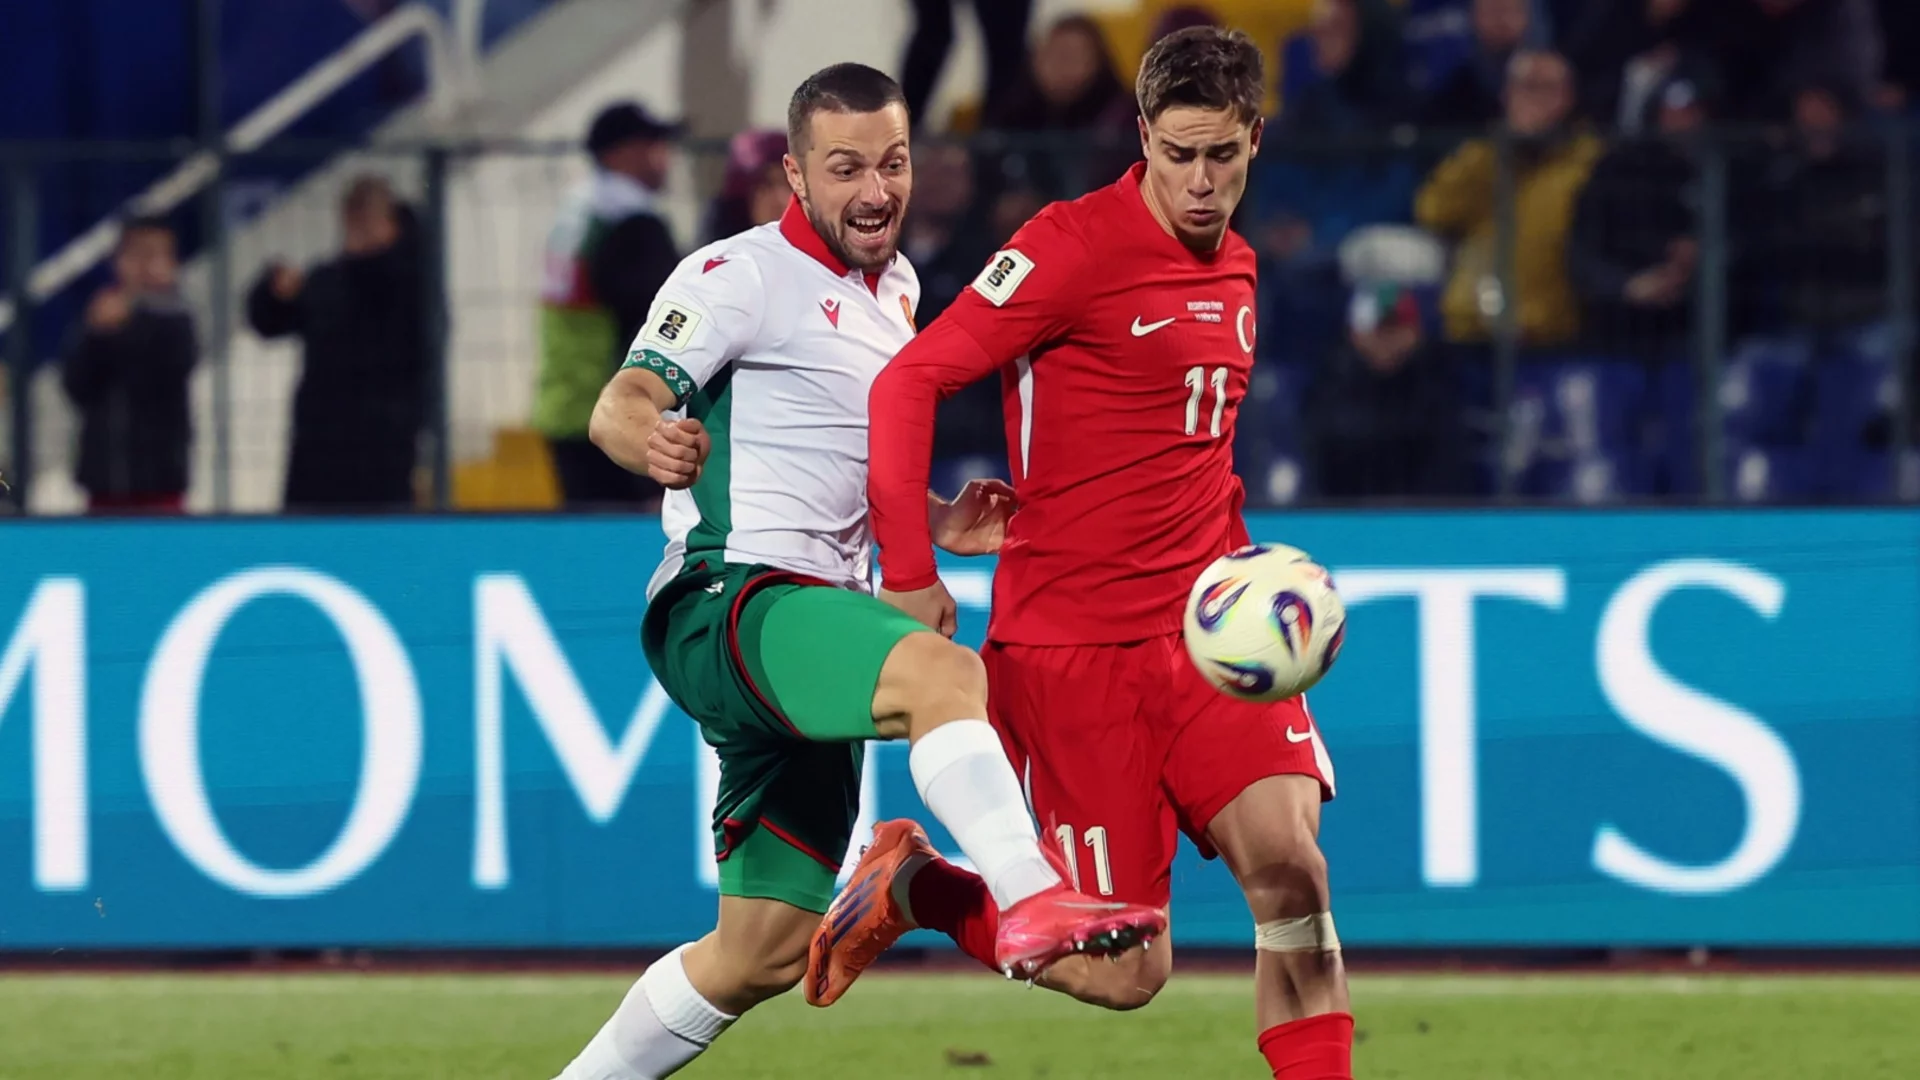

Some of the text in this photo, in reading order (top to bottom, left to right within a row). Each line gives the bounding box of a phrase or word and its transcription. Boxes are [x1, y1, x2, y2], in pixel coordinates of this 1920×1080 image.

[1184, 365, 1229, 438] 11
[0, 560, 1803, 897] OMTS
[1055, 823, 1114, 896] 11
